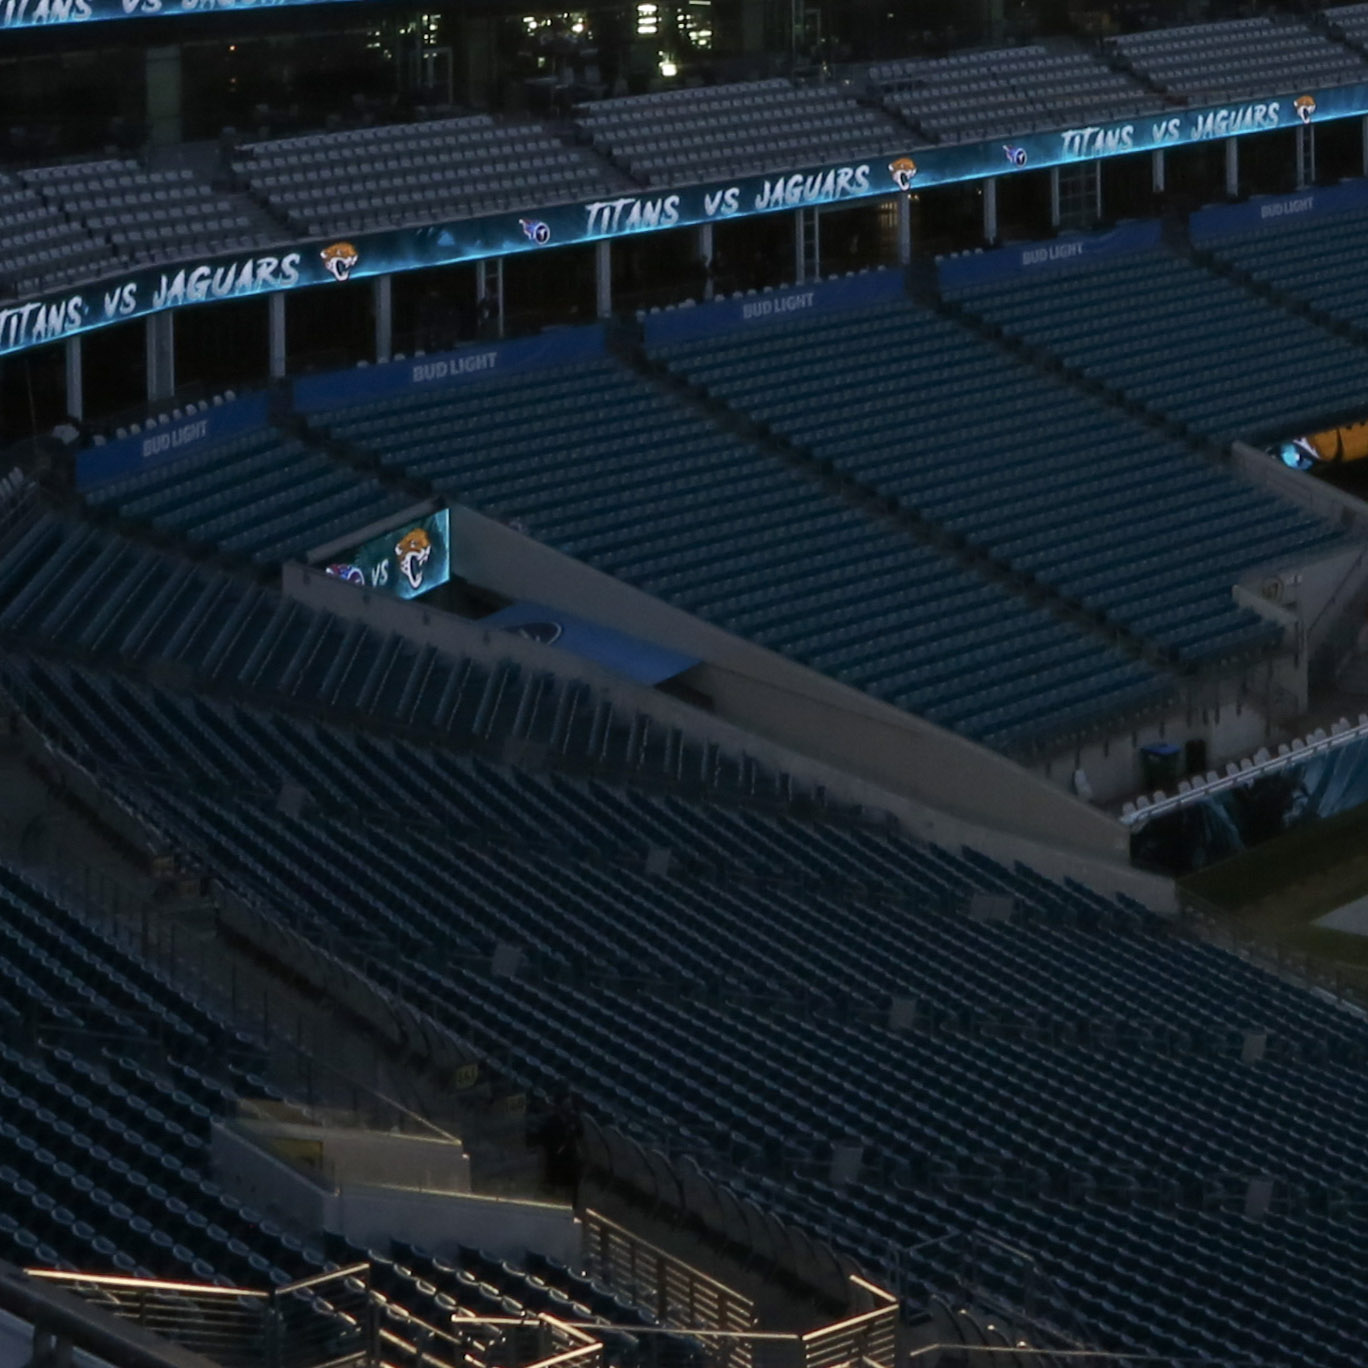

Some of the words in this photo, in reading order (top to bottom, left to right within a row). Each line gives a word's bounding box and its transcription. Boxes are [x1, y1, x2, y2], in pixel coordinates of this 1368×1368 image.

[1060, 124, 1134, 157] TITANS
[1152, 119, 1180, 146] VS
[1191, 102, 1279, 140] JAGUARS
[585, 196, 680, 236] TITANS
[704, 187, 740, 217] VS
[755, 165, 870, 211] JAGUARS
[1262, 204, 1282, 218] BUD
[1284, 196, 1313, 214] LIGHT
[1023, 249, 1046, 264] BUD
[1048, 243, 1082, 262] LIGHT
[104, 285, 137, 317] VS
[153, 254, 301, 307] JAGUARS
[743, 302, 768, 318] BUD
[774, 293, 814, 315] LIGHT
[413, 362, 443, 382] BUD
[450, 352, 497, 376] LIGHT
[142, 434, 170, 457] BUD
[172, 420, 207, 450] LIGHT
[371, 558, 389, 588] VS
